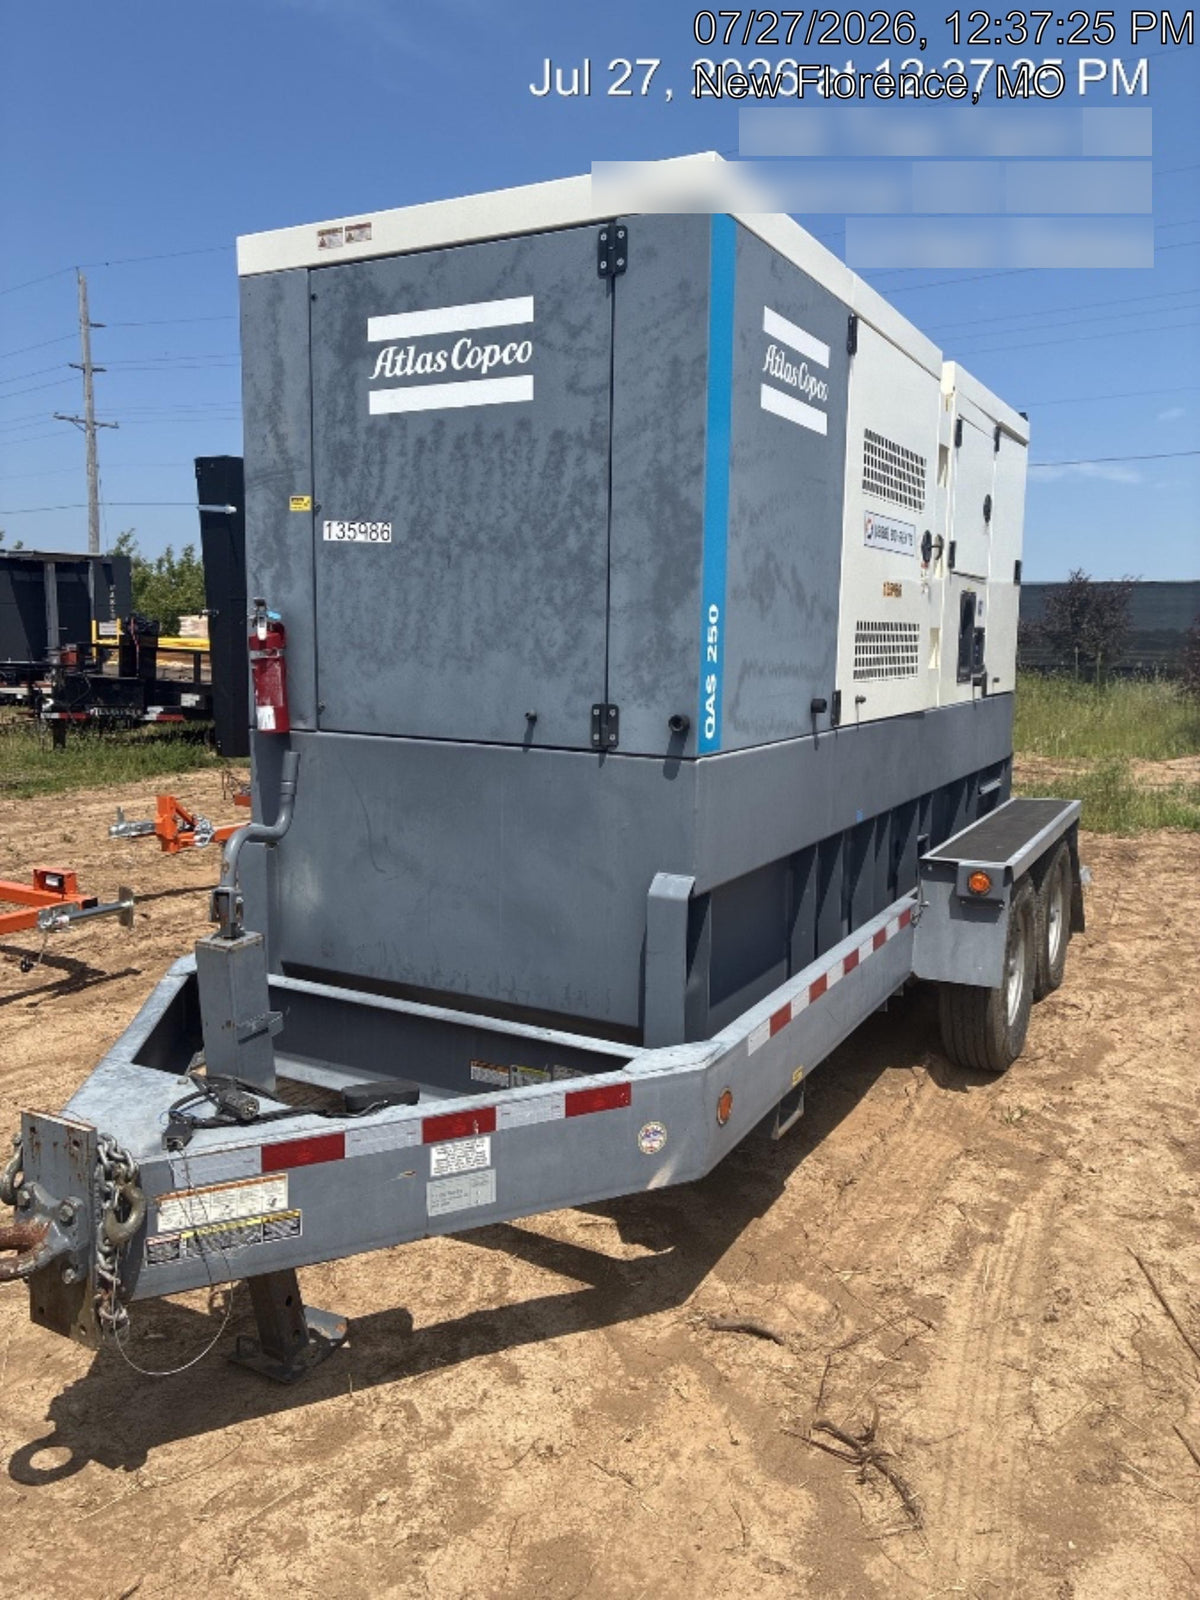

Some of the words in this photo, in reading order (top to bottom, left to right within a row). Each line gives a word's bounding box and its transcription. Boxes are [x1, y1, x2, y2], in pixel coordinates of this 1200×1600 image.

[368, 344, 449, 380] Atlas
[450, 336, 533, 375] Copco
[761, 344, 798, 387] Atlas
[798, 361, 829, 403] Copco
[325, 521, 391, 541] 135986
[706, 603, 719, 663] 250
[704, 673, 718, 740] QAS
